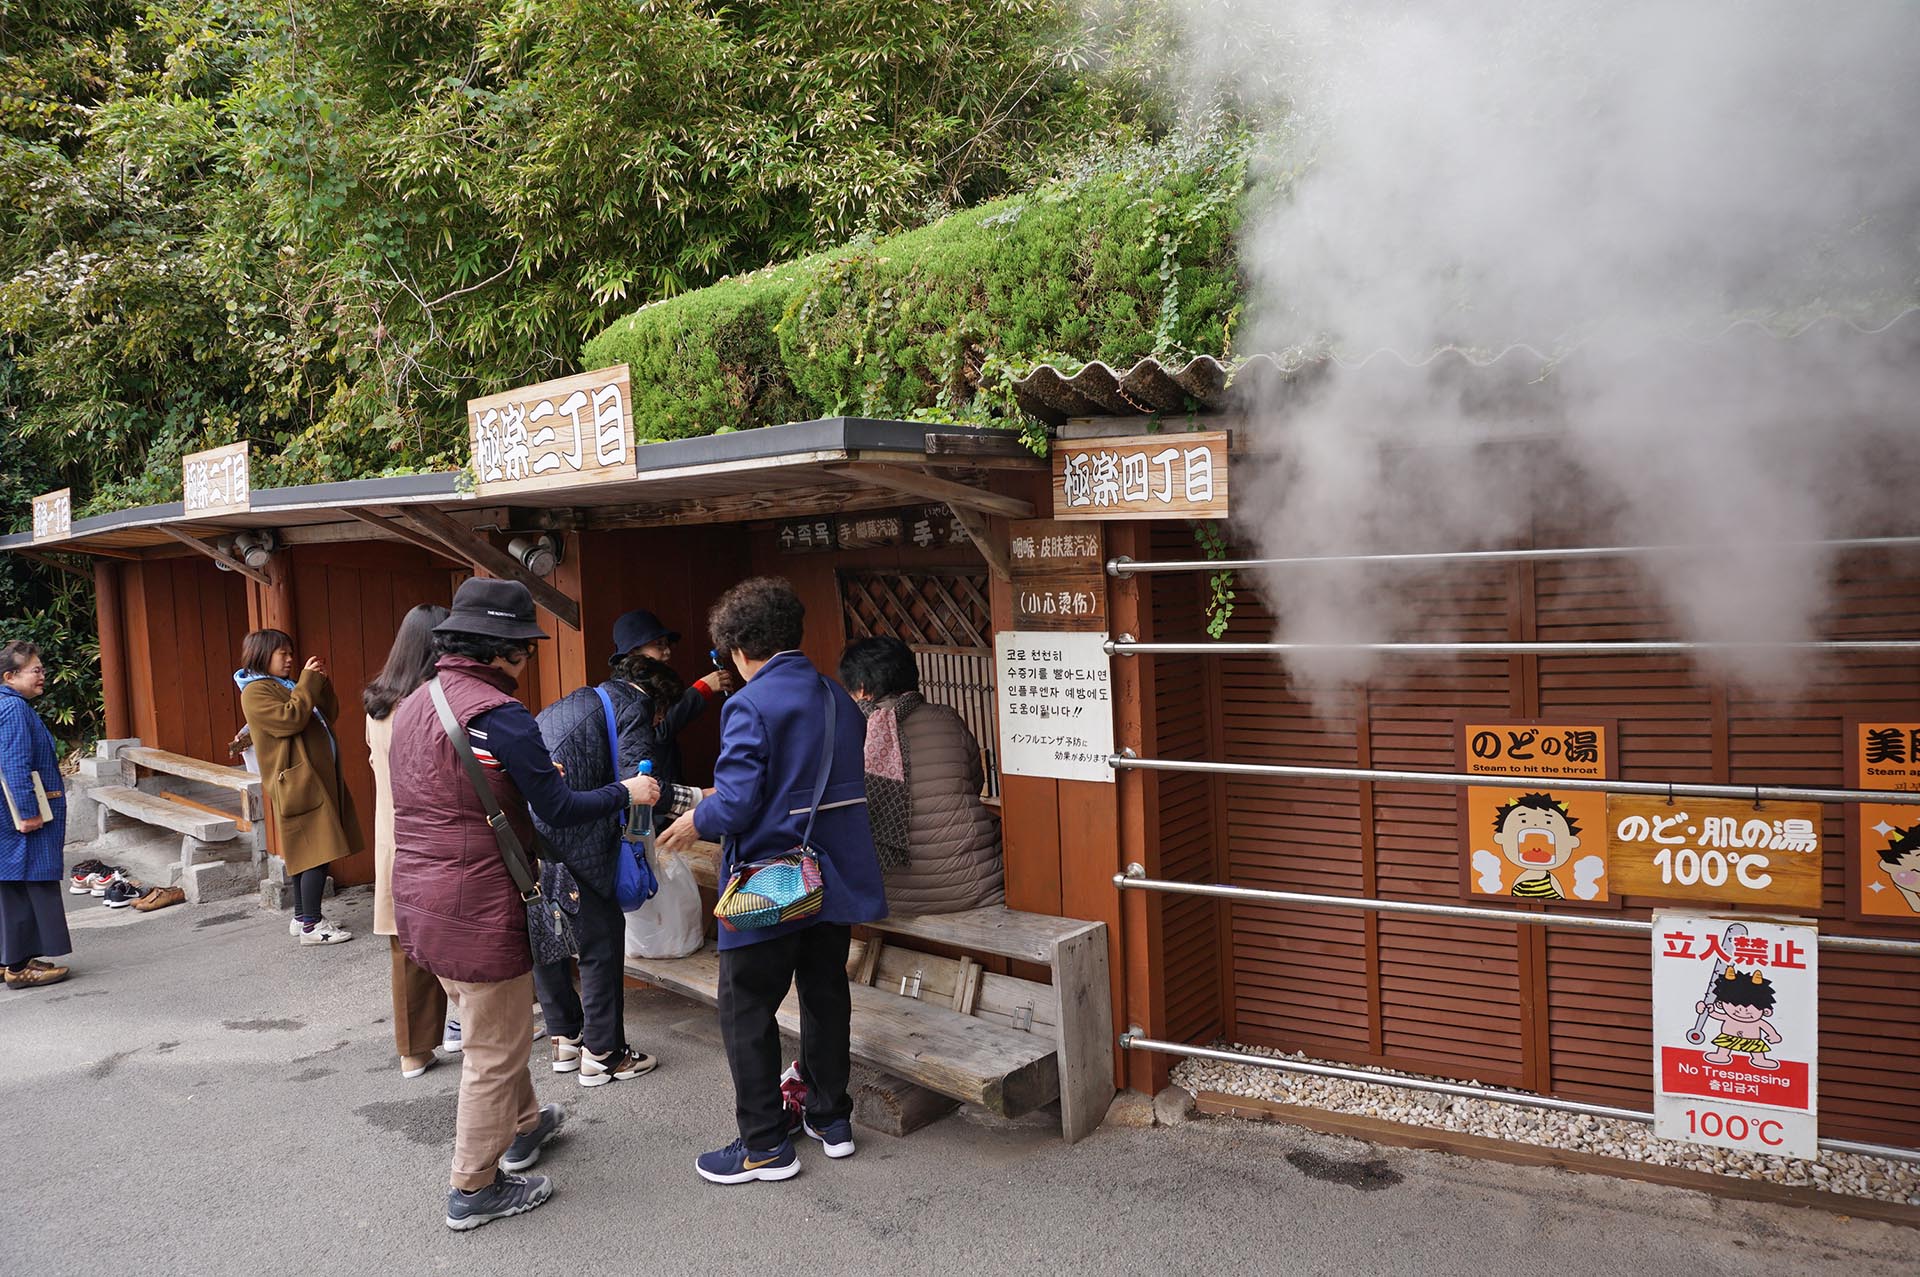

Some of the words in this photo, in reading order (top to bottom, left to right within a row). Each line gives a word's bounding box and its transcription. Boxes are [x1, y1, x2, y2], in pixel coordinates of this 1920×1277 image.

[475, 383, 627, 483] 極楽三丁目
[186, 452, 246, 510] 極楽二丁目
[1063, 445, 1214, 508] 極楽四丁目
[781, 522, 830, 547] 수족욕
[1007, 649, 1027, 661] 코로
[1031, 650, 1062, 661] 천천히
[1007, 667, 1048, 679] 수증기를
[1008, 686, 1060, 698] 인플루엔자
[1065, 688, 1108, 701] 예방에도
[1011, 733, 1088, 748] インフルエンザ予防に
[1472, 728, 1598, 763] のどの湯
[1473, 764, 1506, 773] Steam
[1510, 765, 1521, 773] to
[1524, 765, 1538, 773] hit
[1541, 766, 1559, 774] the
[1562, 766, 1598, 774] throat
[1867, 767, 1906, 776] Steam
[1617, 811, 1818, 853] のど・肌の湯
[1663, 931, 1807, 969] 立入禁止
[1678, 1063, 1698, 1075] No
[1702, 1065, 1791, 1088] Trespassing
[1709, 1079, 1759, 1096] 출입금지
